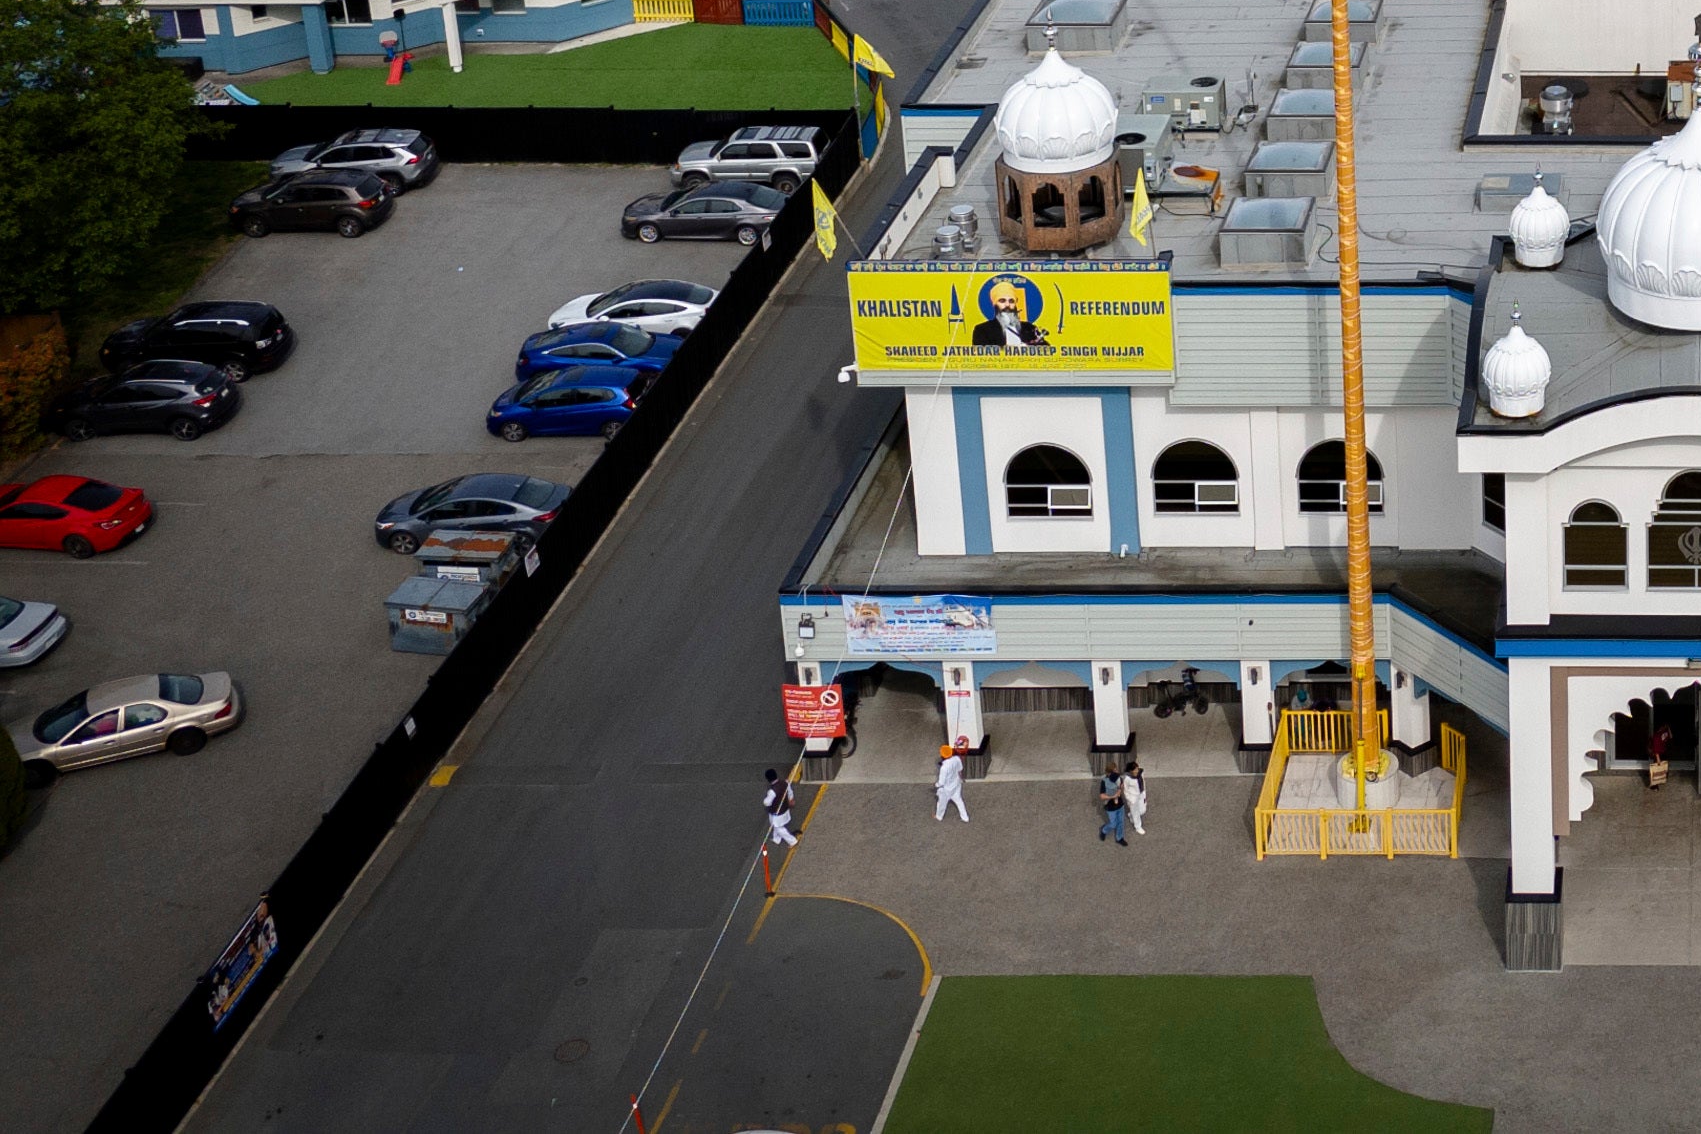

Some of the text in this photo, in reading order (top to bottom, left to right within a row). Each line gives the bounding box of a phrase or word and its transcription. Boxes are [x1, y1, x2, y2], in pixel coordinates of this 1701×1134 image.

[857, 299, 1165, 318] KHALISTAN REFERENDUM
[885, 345, 1145, 357] SHAHEED JATHEDAR HARDEEP SINGH NIJJAR
